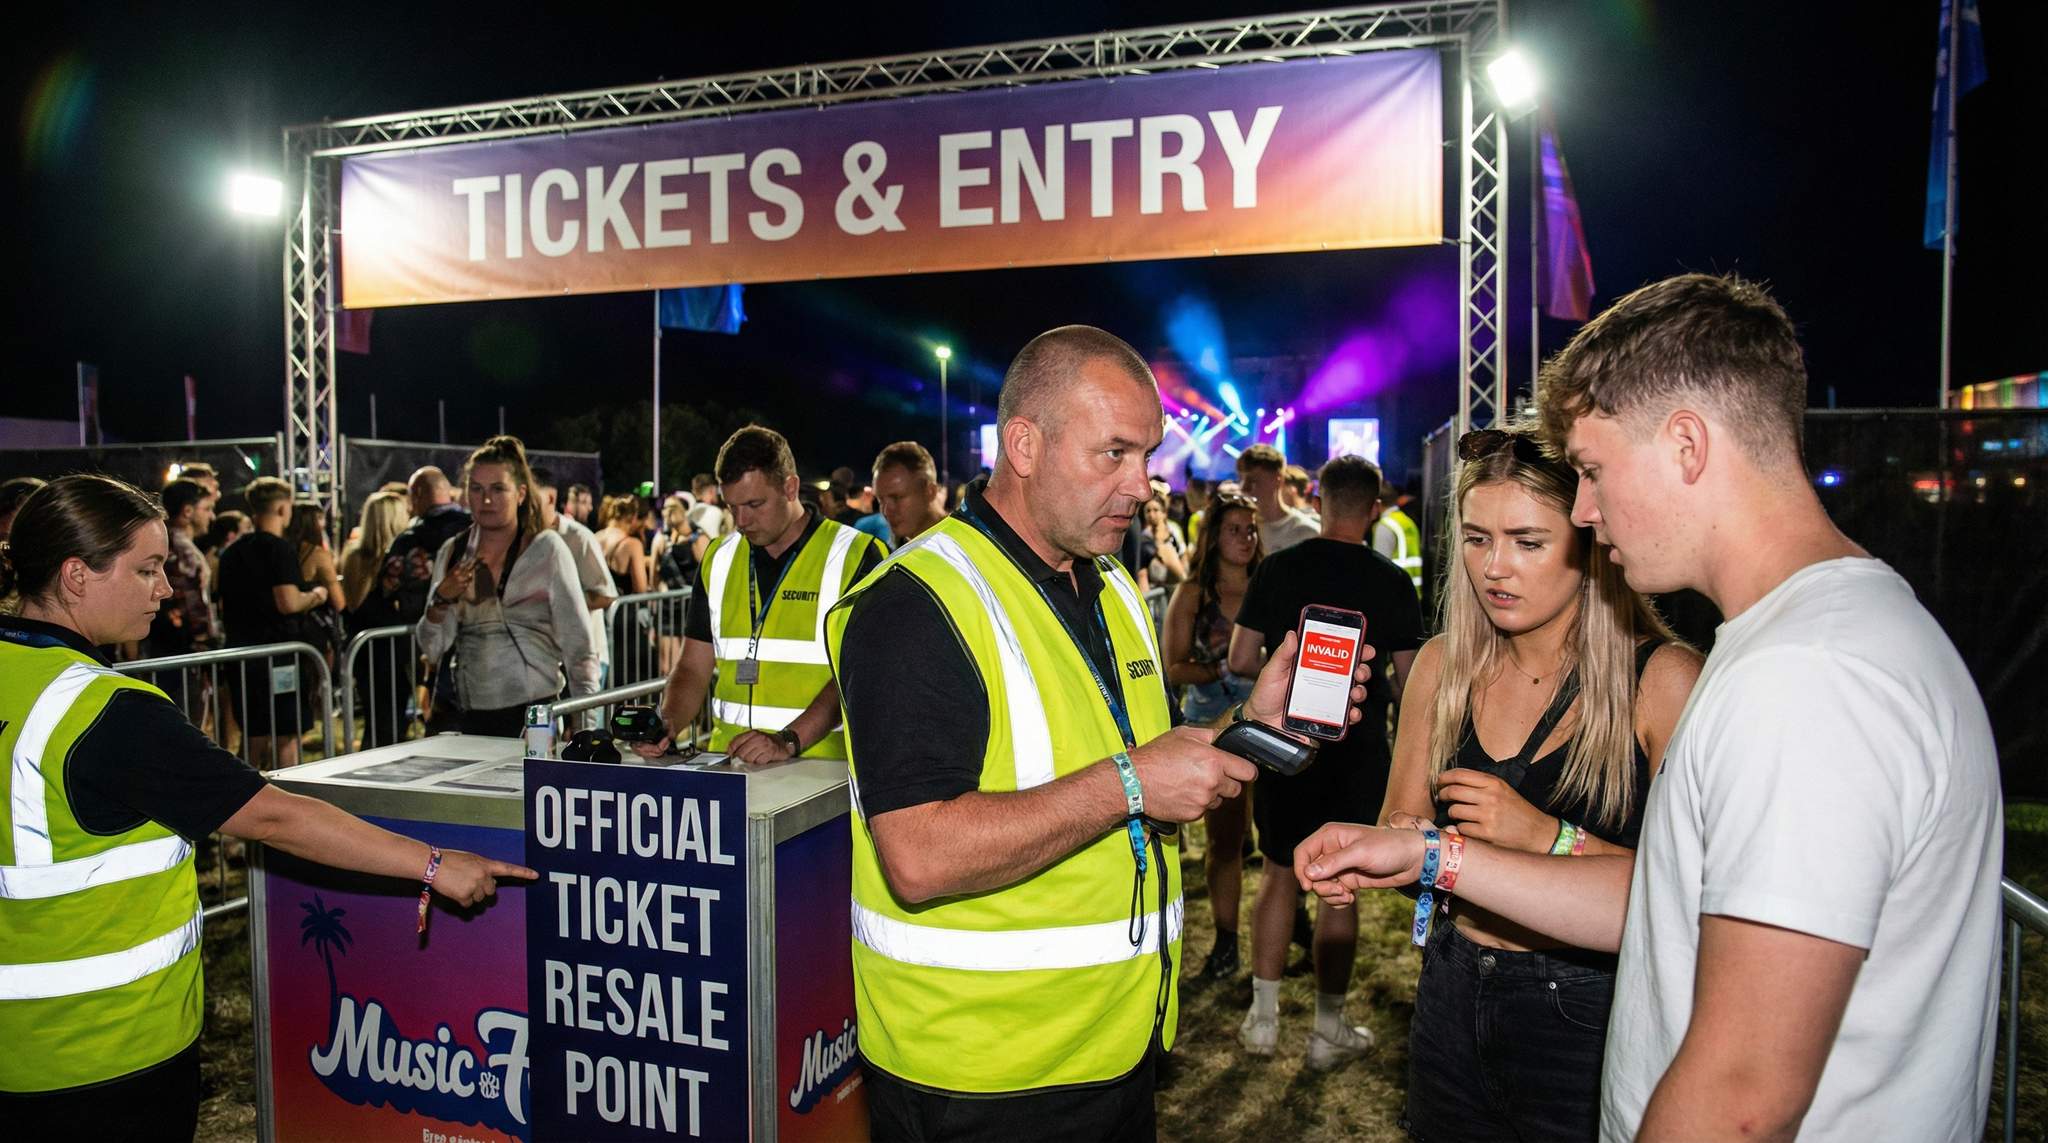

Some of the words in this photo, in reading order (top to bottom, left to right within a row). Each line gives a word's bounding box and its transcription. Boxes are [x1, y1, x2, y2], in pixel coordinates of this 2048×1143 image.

[453, 148, 805, 262] TICKETS
[834, 140, 906, 236] &
[939, 105, 1283, 228] ENTRY
[1307, 643, 1350, 660] INVALID
[535, 785, 735, 866] OFFICIAL
[549, 872, 720, 957] TICKET
[310, 997, 475, 1098] Music
[545, 959, 729, 1051] RESALE
[566, 1050, 709, 1137] POINT
[790, 1018, 857, 1108] Music
